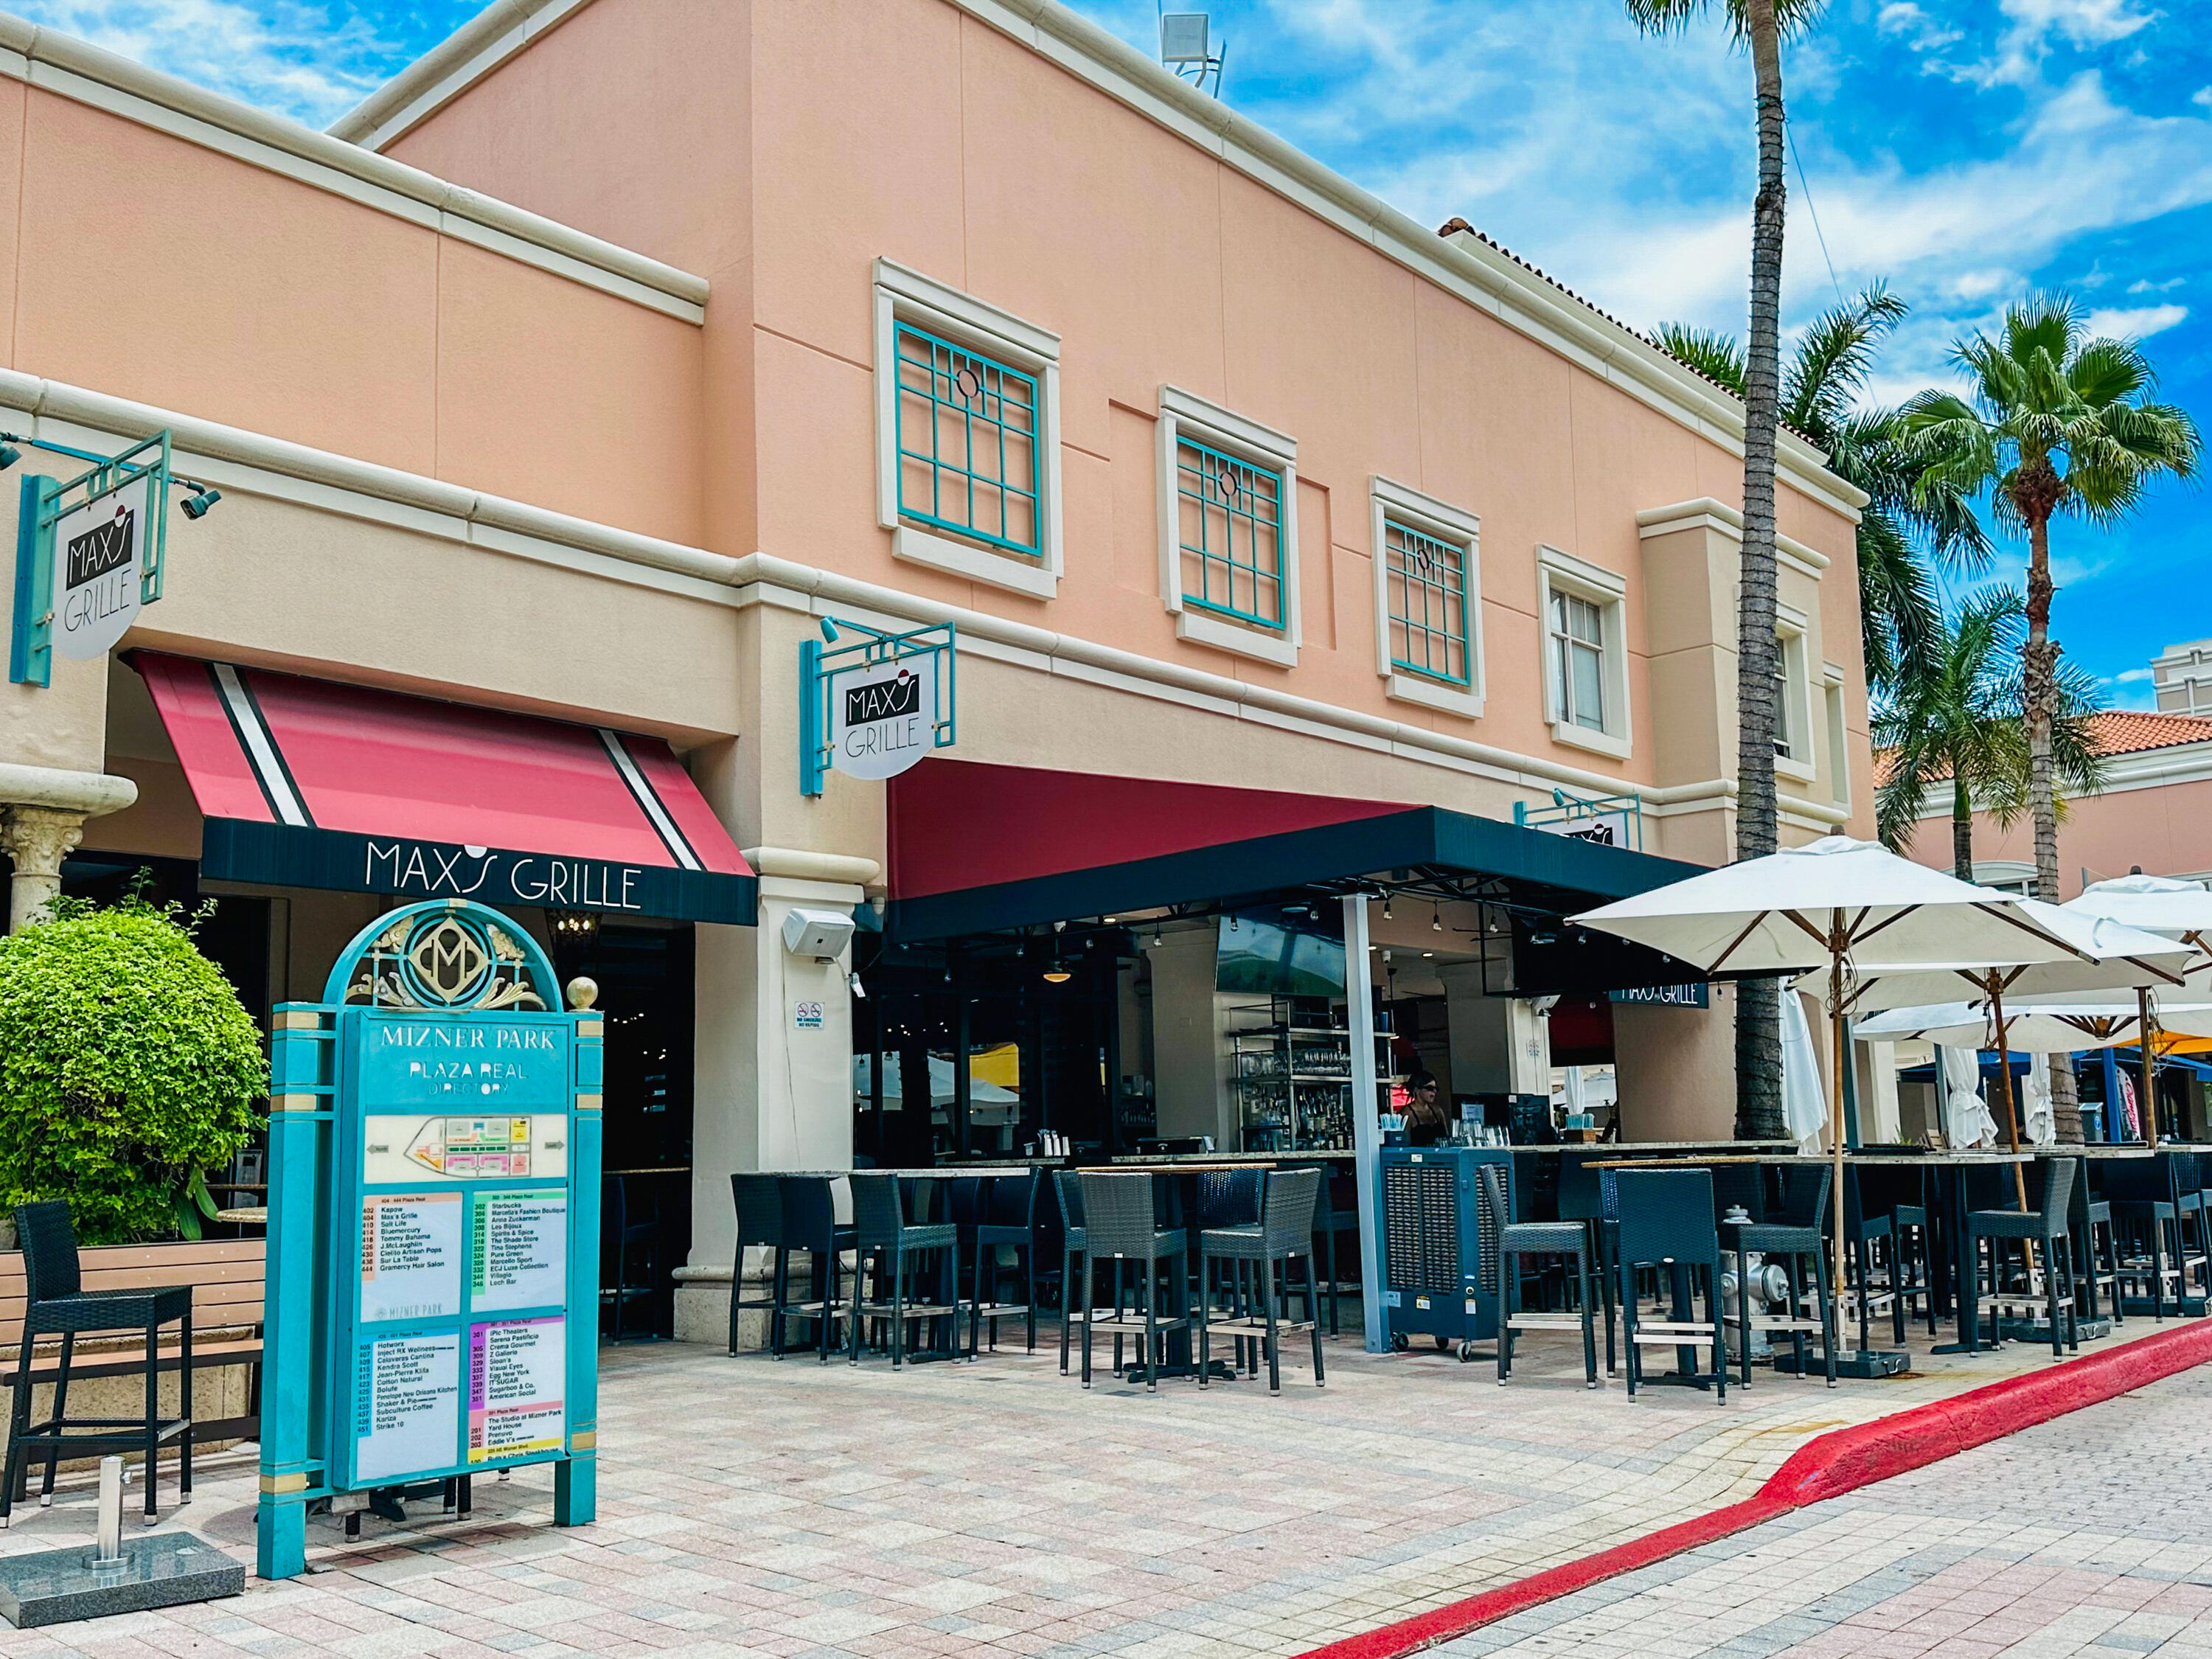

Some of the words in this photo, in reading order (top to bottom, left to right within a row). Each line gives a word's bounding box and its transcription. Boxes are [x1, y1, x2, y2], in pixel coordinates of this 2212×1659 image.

[64, 568, 132, 632] GRILLE
[845, 717, 919, 758] GRILLE
[511, 858, 642, 910] GRILLE
[381, 1026, 487, 1048] MIZNER
[496, 1029, 557, 1049] PARK
[409, 1062, 475, 1079] PLAZA
[479, 1062, 529, 1079] REAL
[428, 1082, 510, 1096] DIRECTORY
[422, 1303, 442, 1316] PARK
[377, 1370, 414, 1379] Jean-Pierre
[377, 1378, 399, 1386] Cotton
[489, 1385, 518, 1394] Sugarboo
[518, 1389, 536, 1397] Social
[376, 1400, 399, 1408] Shaker
[376, 1407, 411, 1416] Subculture
